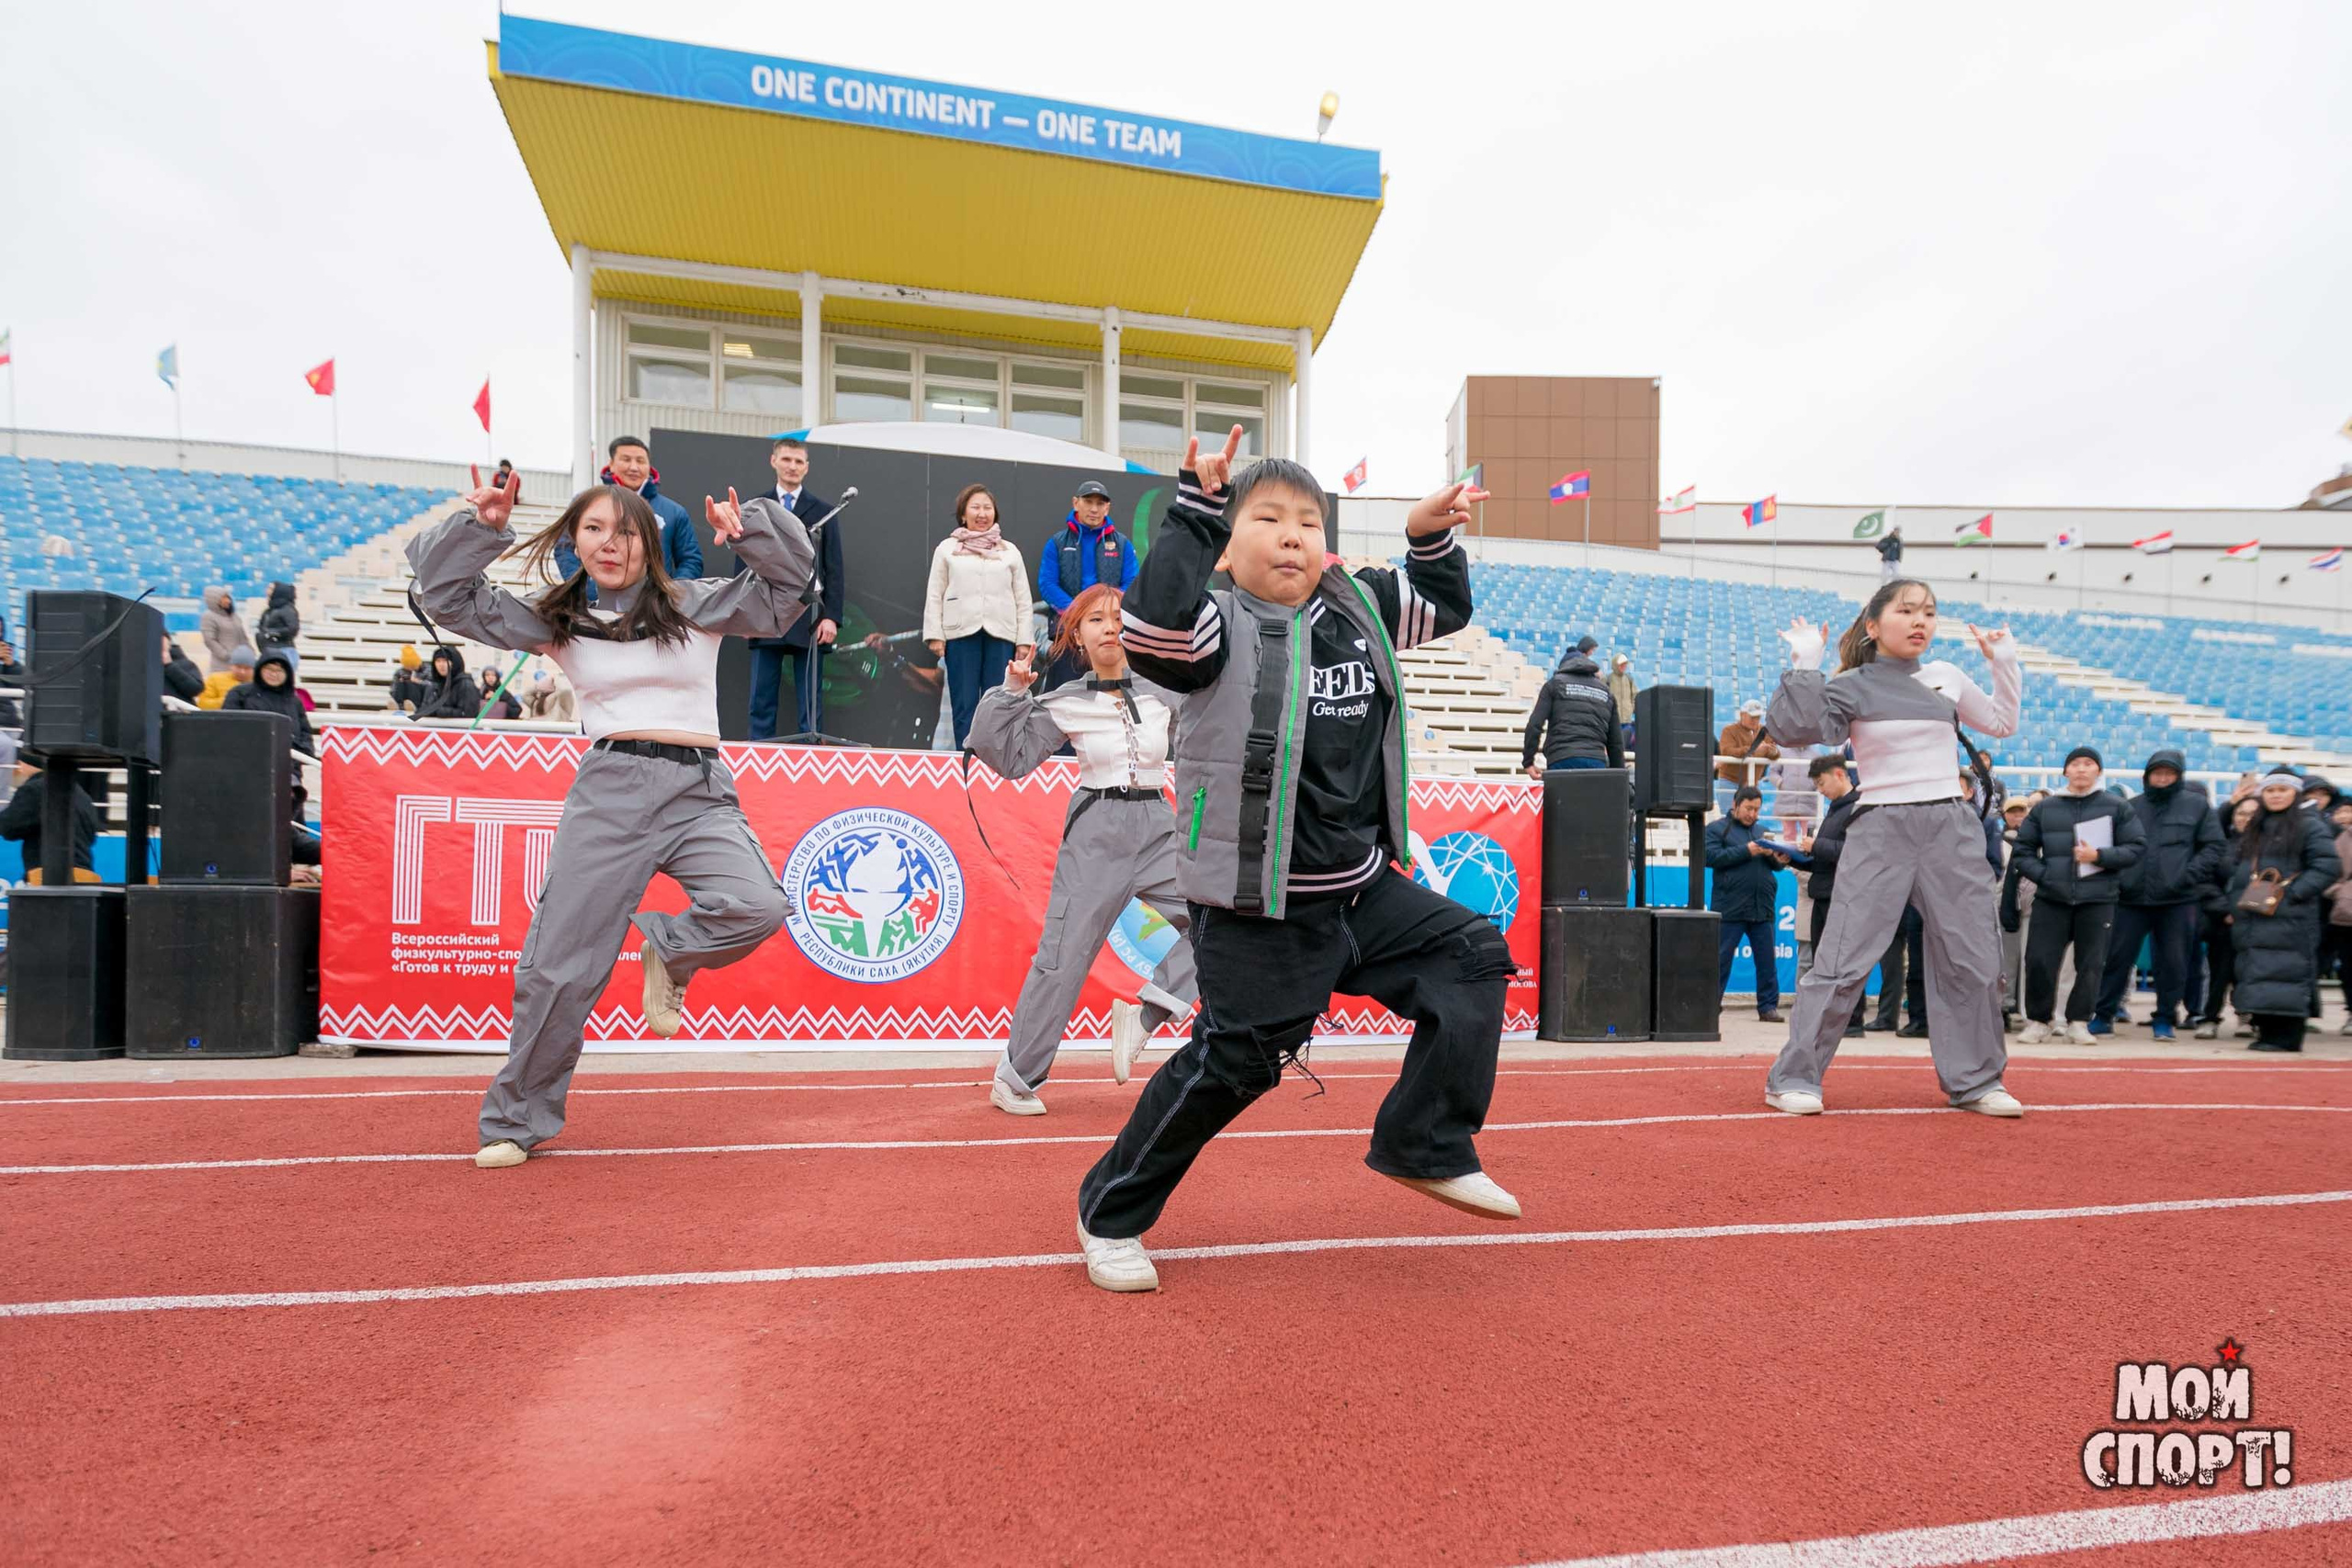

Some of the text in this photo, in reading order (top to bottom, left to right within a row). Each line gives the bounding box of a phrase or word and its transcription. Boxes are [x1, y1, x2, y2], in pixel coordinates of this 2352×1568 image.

[751, 65, 817, 103] ONE
[824, 76, 996, 129] CONTINENT
[1036, 108, 1096, 144] ONE
[1104, 118, 1182, 158] TEAM
[1312, 701, 1369, 717] Get ready
[392, 795, 567, 925] ГТ
[787, 811, 959, 929] МНИСТЕРСТВО ПО ФИЗИЧЕСКОЙ КУЛЬТУРЕ И СПОРТУ
[391, 931, 500, 947] Всероссийский
[799, 931, 948, 978] РЕСПУБЛИКИ САХА (ЯКУТИЯ)
[391, 960, 509, 976] «Готов к труду и
